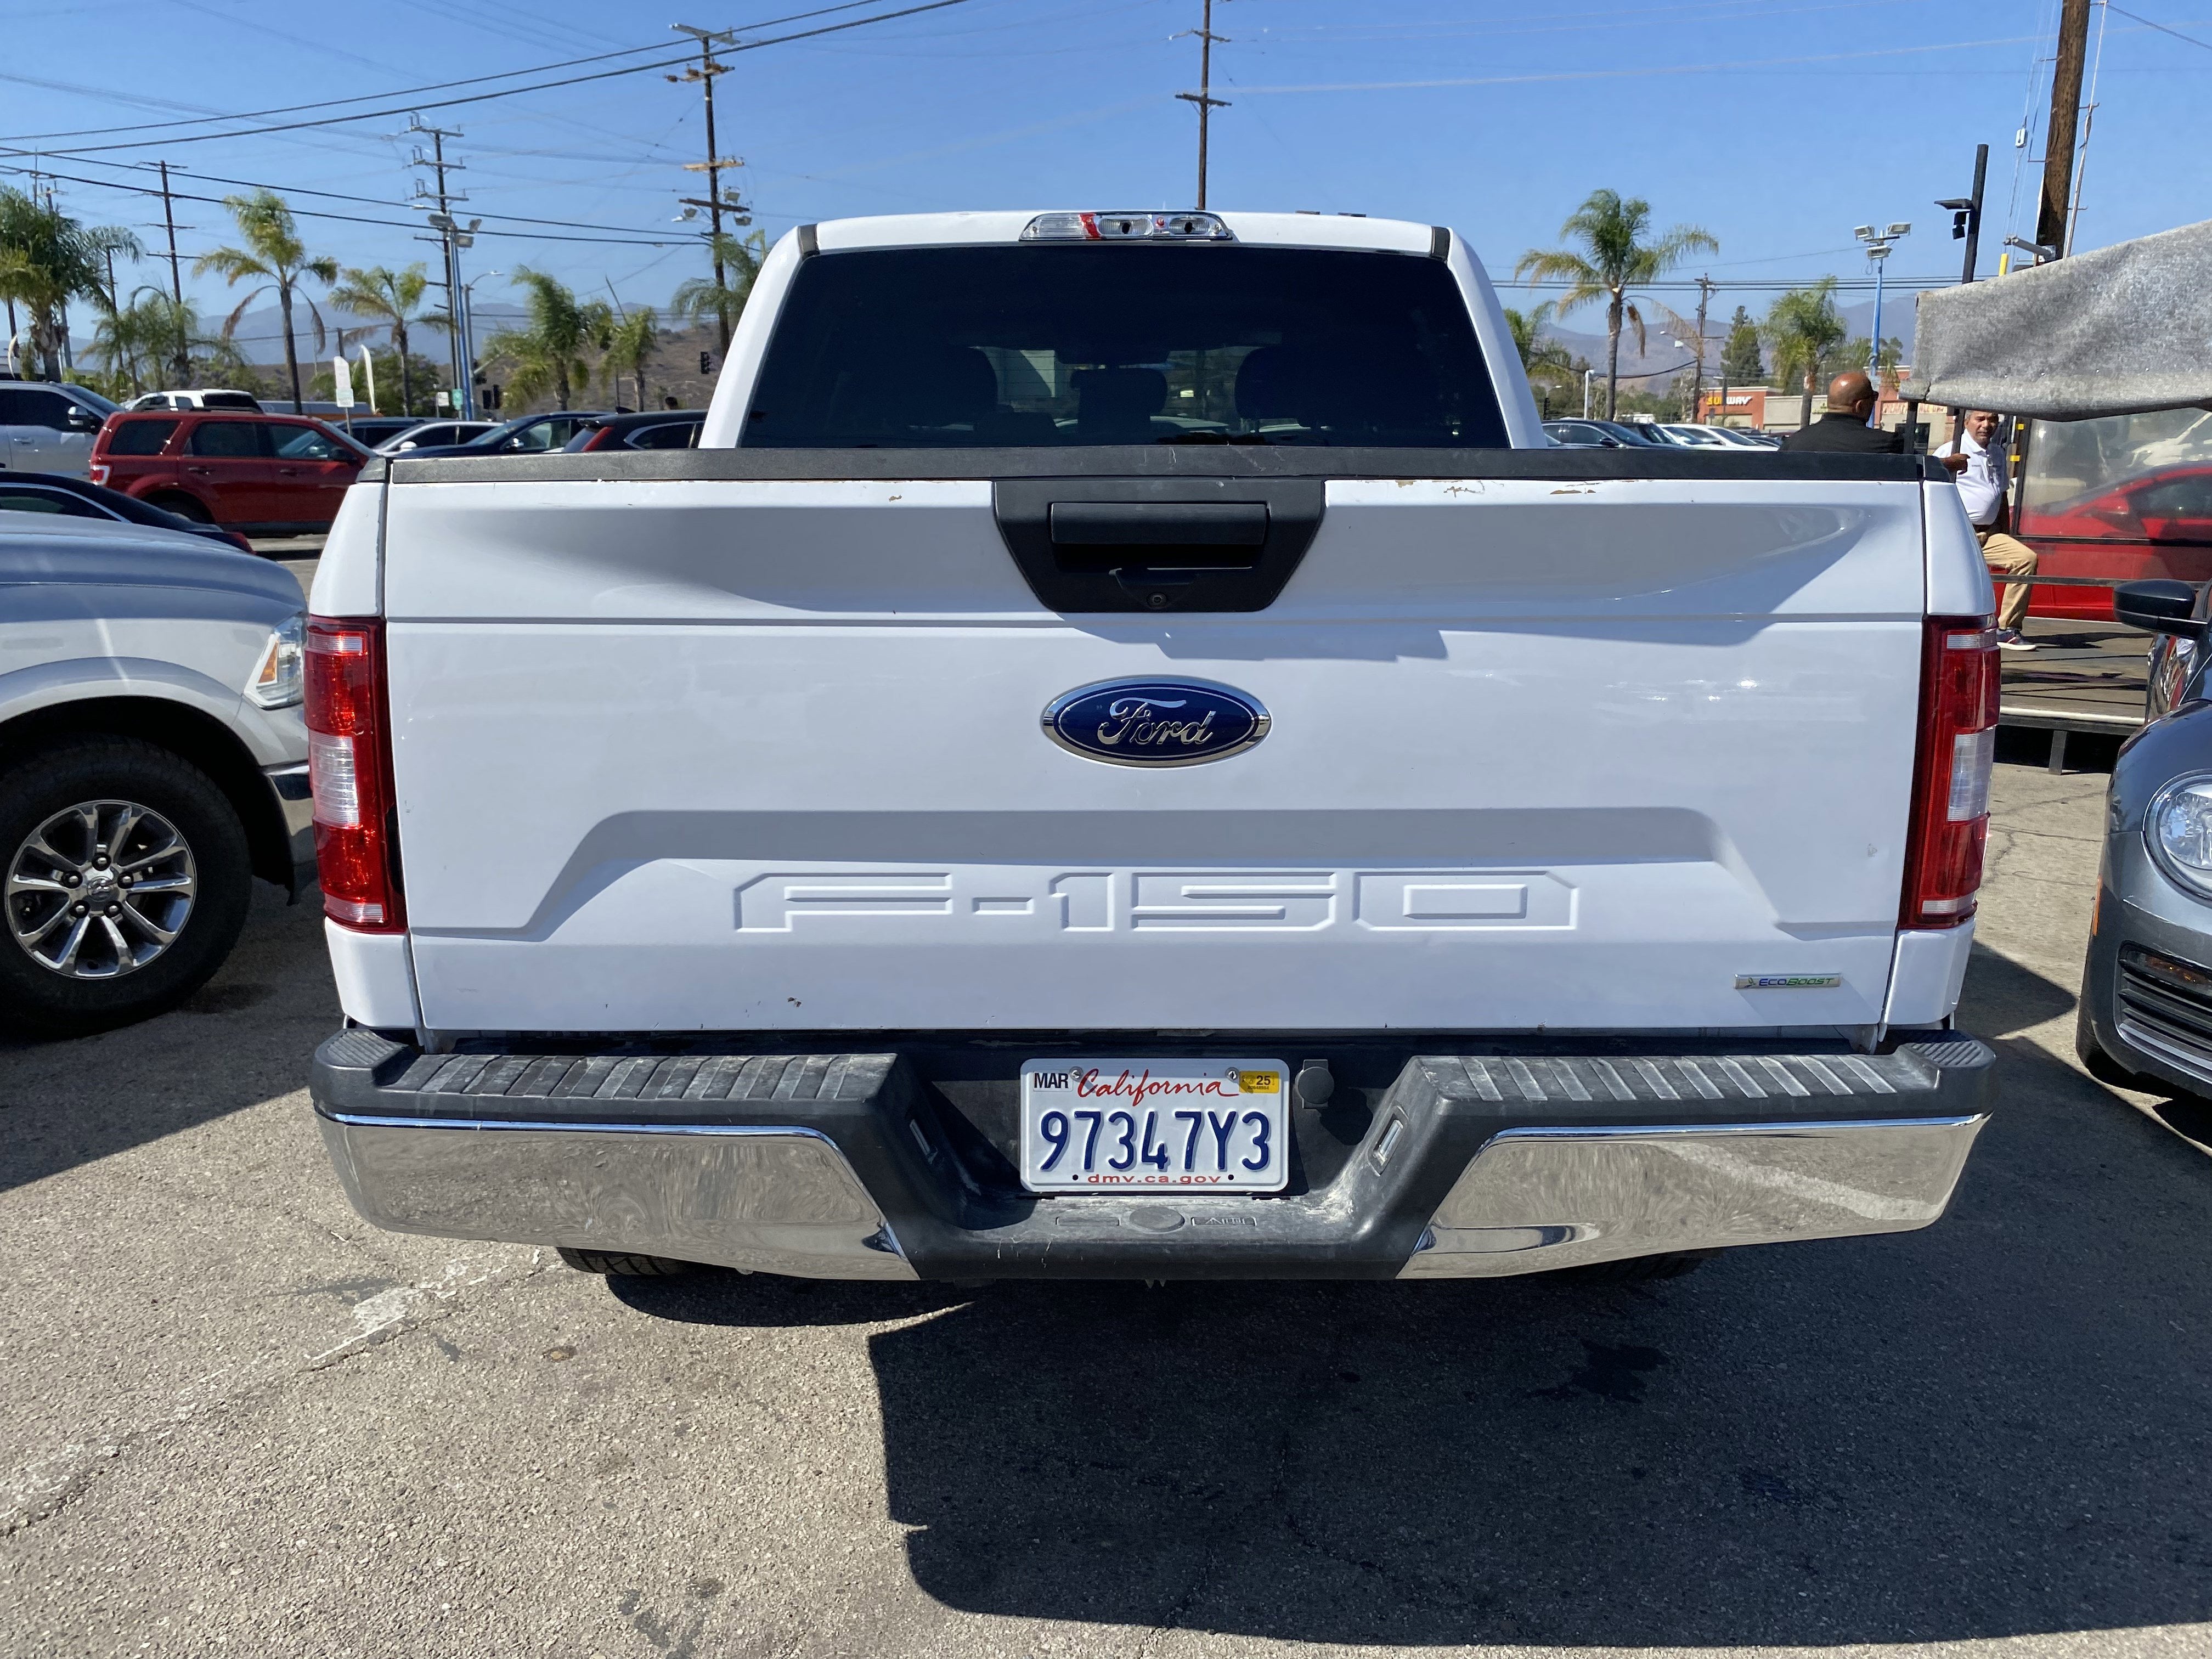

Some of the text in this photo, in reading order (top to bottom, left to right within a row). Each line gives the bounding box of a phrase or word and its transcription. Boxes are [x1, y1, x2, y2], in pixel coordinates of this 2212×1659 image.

[1706, 396, 1752, 405] SUWAY
[1097, 697, 1216, 745] Ford
[733, 871, 1580, 933] F-150
[1034, 1073, 1069, 1089] MAR
[1077, 1068, 1239, 1107] California
[1256, 1075, 1271, 1085] 25
[1040, 1111, 1269, 1171] 97347Y3
[1087, 1173, 1221, 1184] dmv.ca.gov
